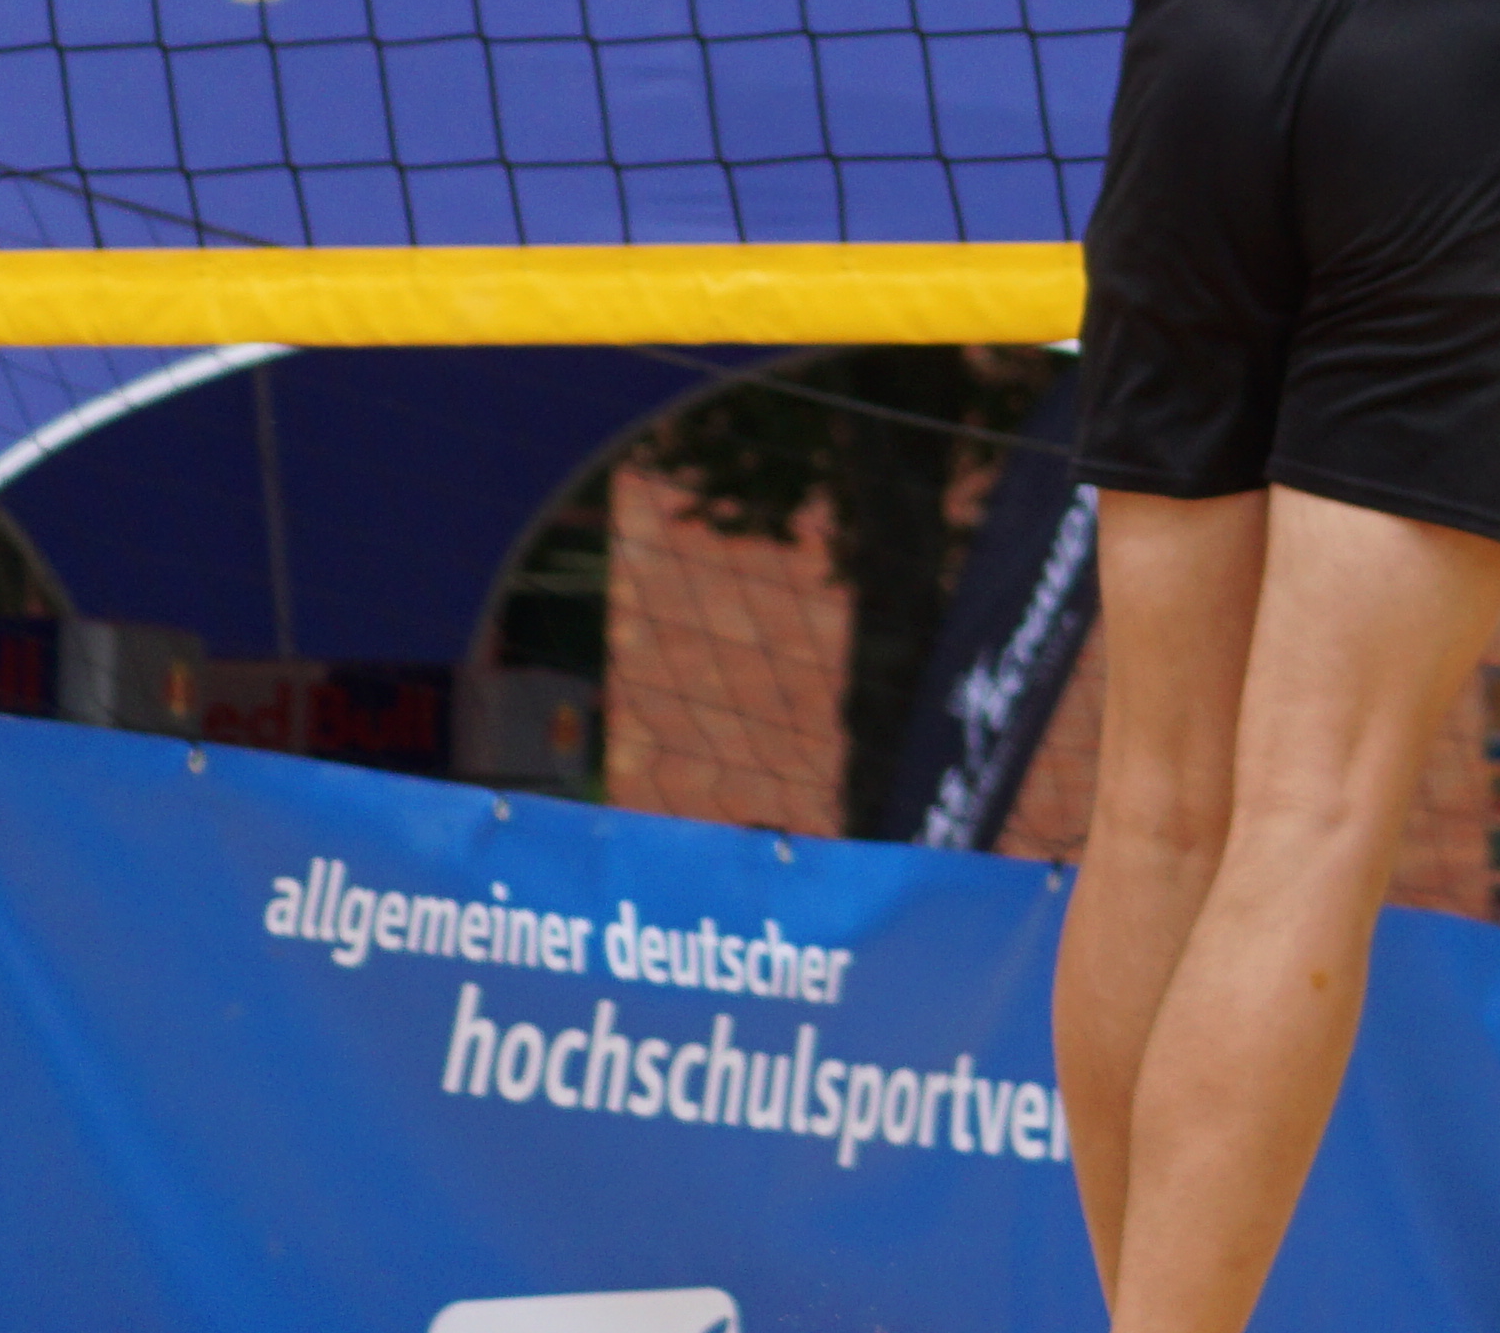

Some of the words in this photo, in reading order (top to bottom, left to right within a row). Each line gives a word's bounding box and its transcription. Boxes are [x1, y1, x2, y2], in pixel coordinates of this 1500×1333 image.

[264, 856, 593, 974] allgemeiner
[604, 899, 852, 1005] deutscher
[441, 982, 1074, 1169] hochschulsportver
